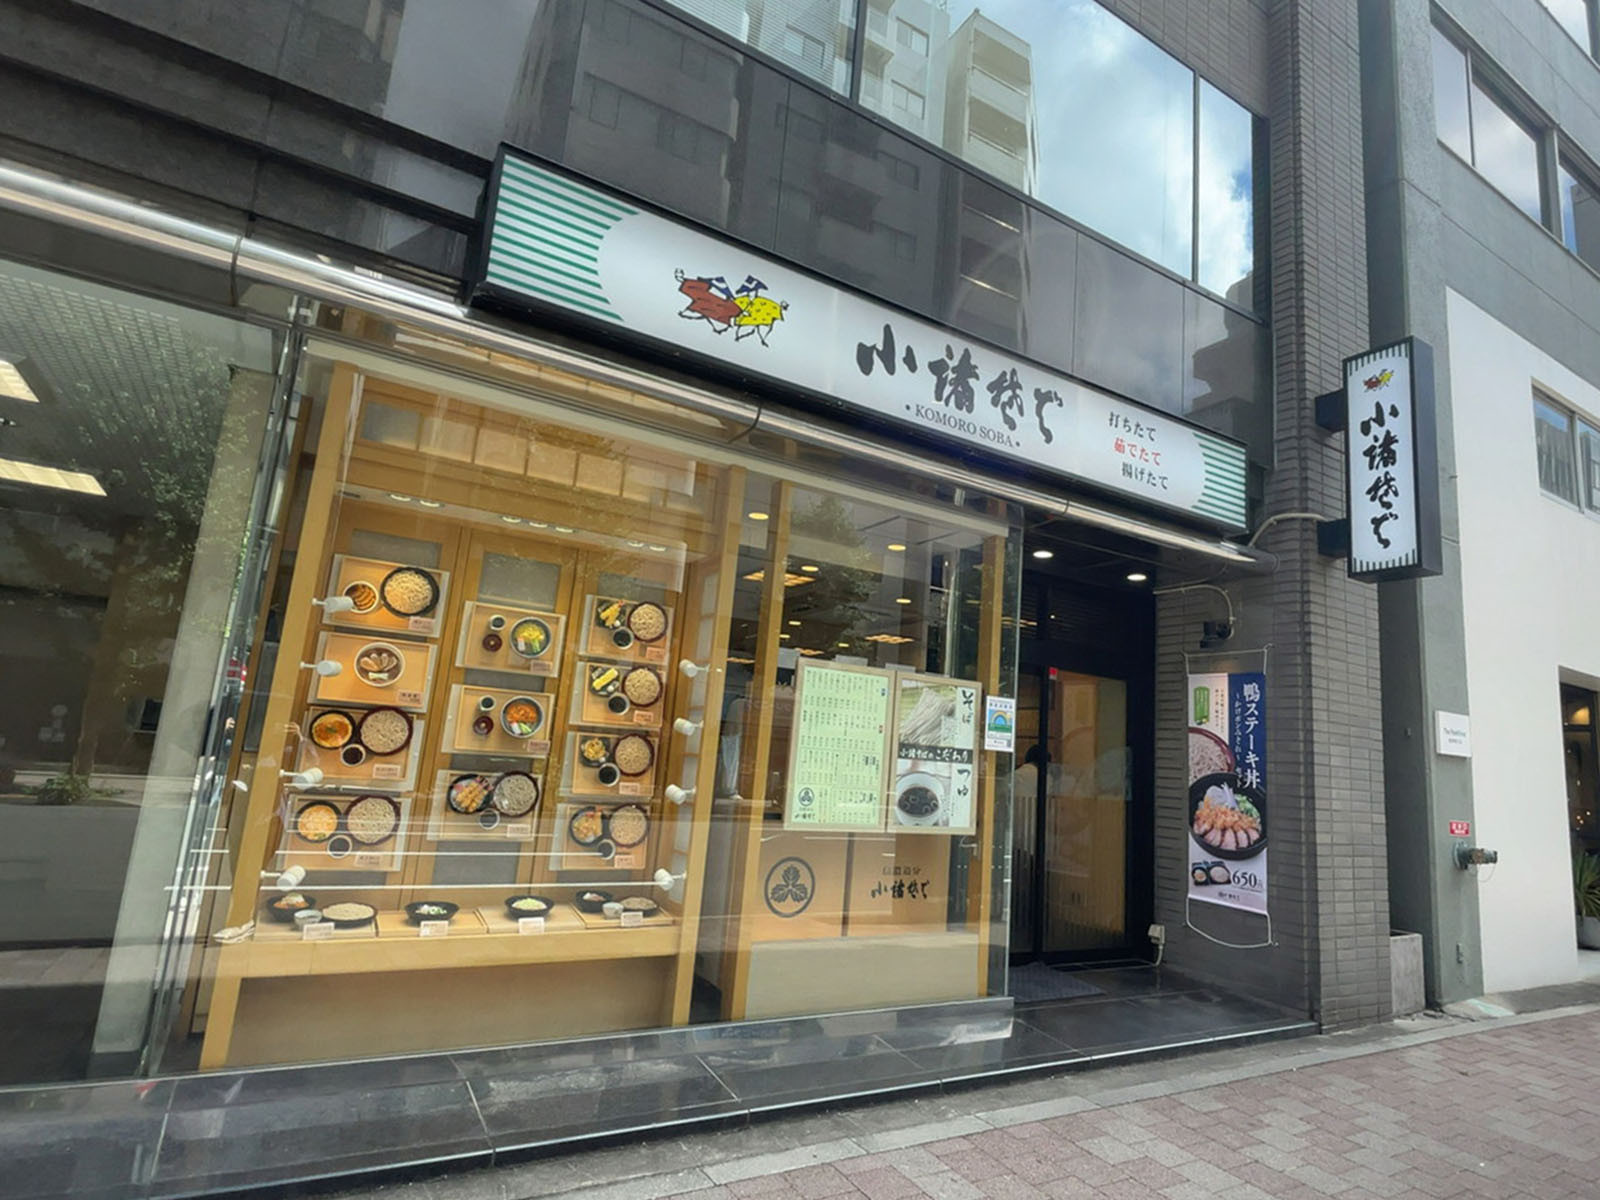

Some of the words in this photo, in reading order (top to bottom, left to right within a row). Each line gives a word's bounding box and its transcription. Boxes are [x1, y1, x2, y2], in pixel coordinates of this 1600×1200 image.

[915, 404, 977, 435] KOMORO
[979, 426, 1013, 447] SOBA
[1109, 411, 1156, 442] 打ちたて
[1114, 437, 1162, 466] 茹でたて
[1122, 462, 1169, 490] 揚げたて
[961, 690, 974, 724] そば
[1243, 682, 1261, 789] 鴨ステーキ丼
[957, 769, 971, 796] つゆ
